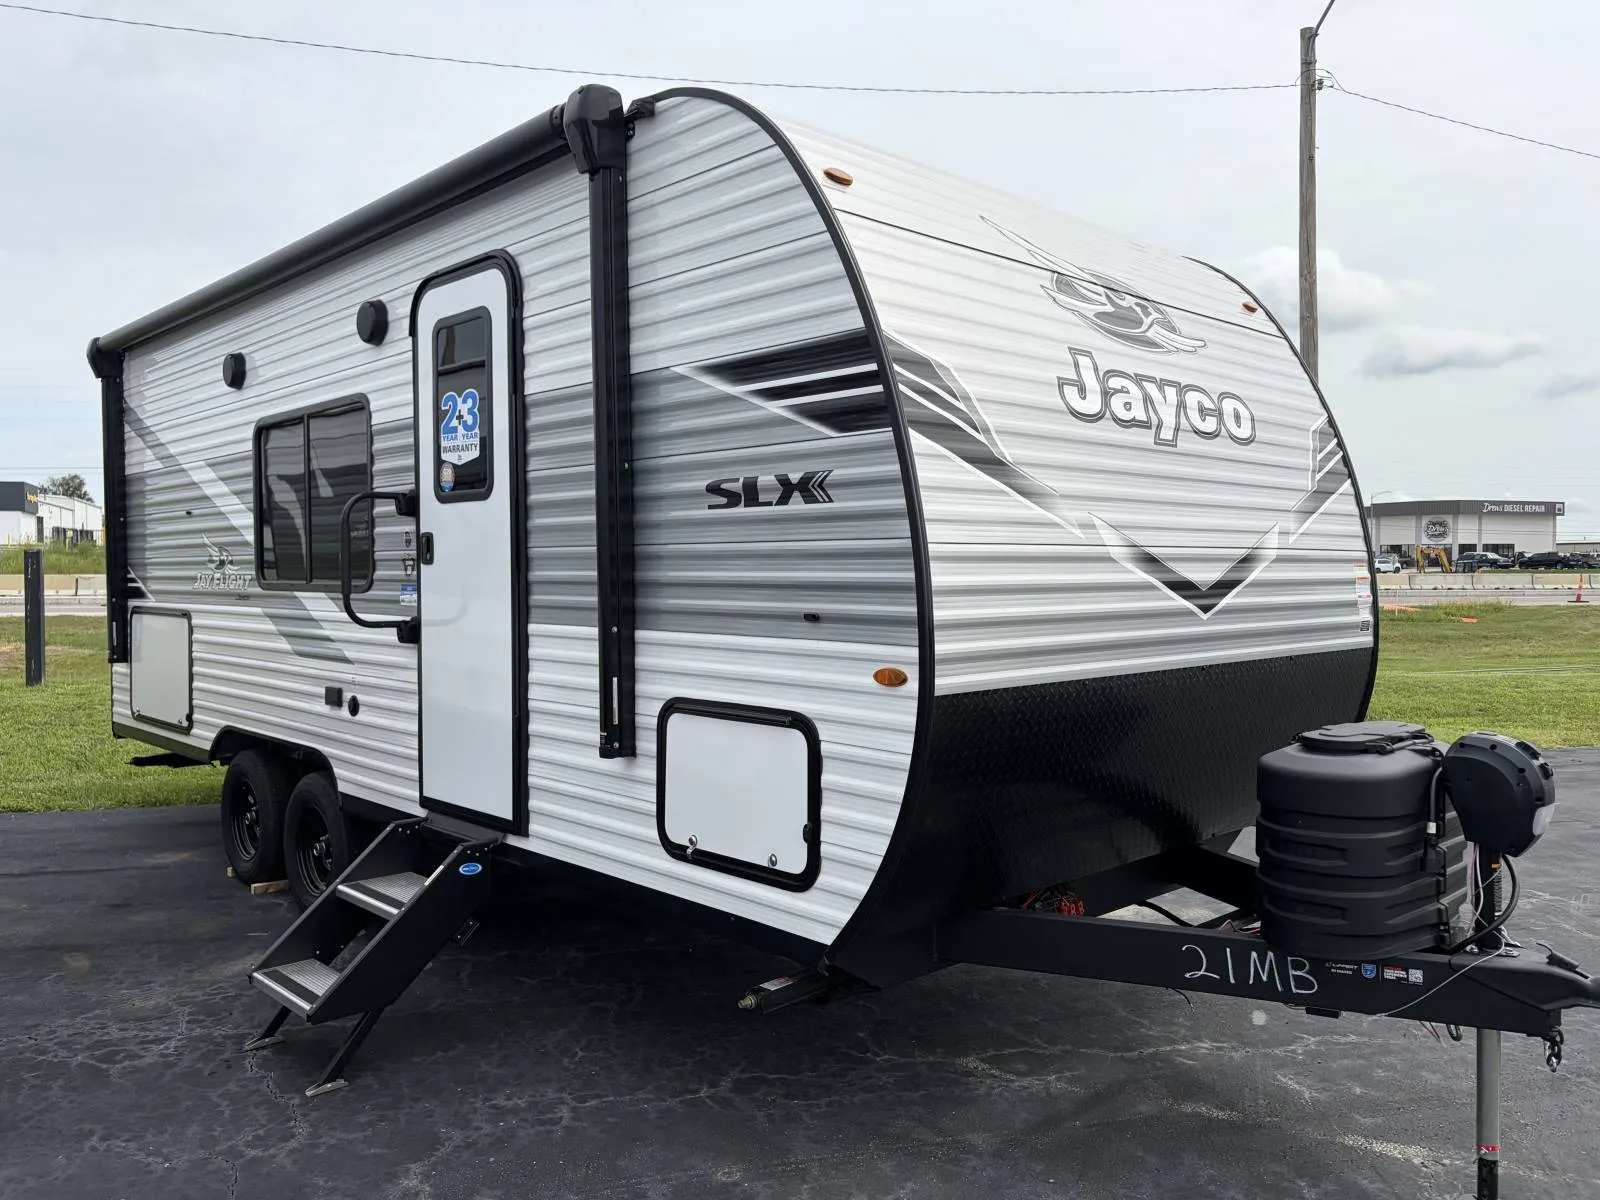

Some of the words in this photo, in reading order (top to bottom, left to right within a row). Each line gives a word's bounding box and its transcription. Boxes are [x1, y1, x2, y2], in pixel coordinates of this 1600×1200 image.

[1056, 346, 1256, 448] Jayco
[443, 434, 458, 442] YEAR
[462, 431, 478, 440] YEAR
[442, 443, 478, 454] WARRANTY
[705, 469, 834, 510] SLX
[1504, 504, 1523, 512] DIESEL
[1524, 504, 1545, 513] REPAIR
[192, 573, 213, 590] JAY
[213, 573, 252, 591] FLIGHT
[1181, 944, 1318, 994] 21MB
